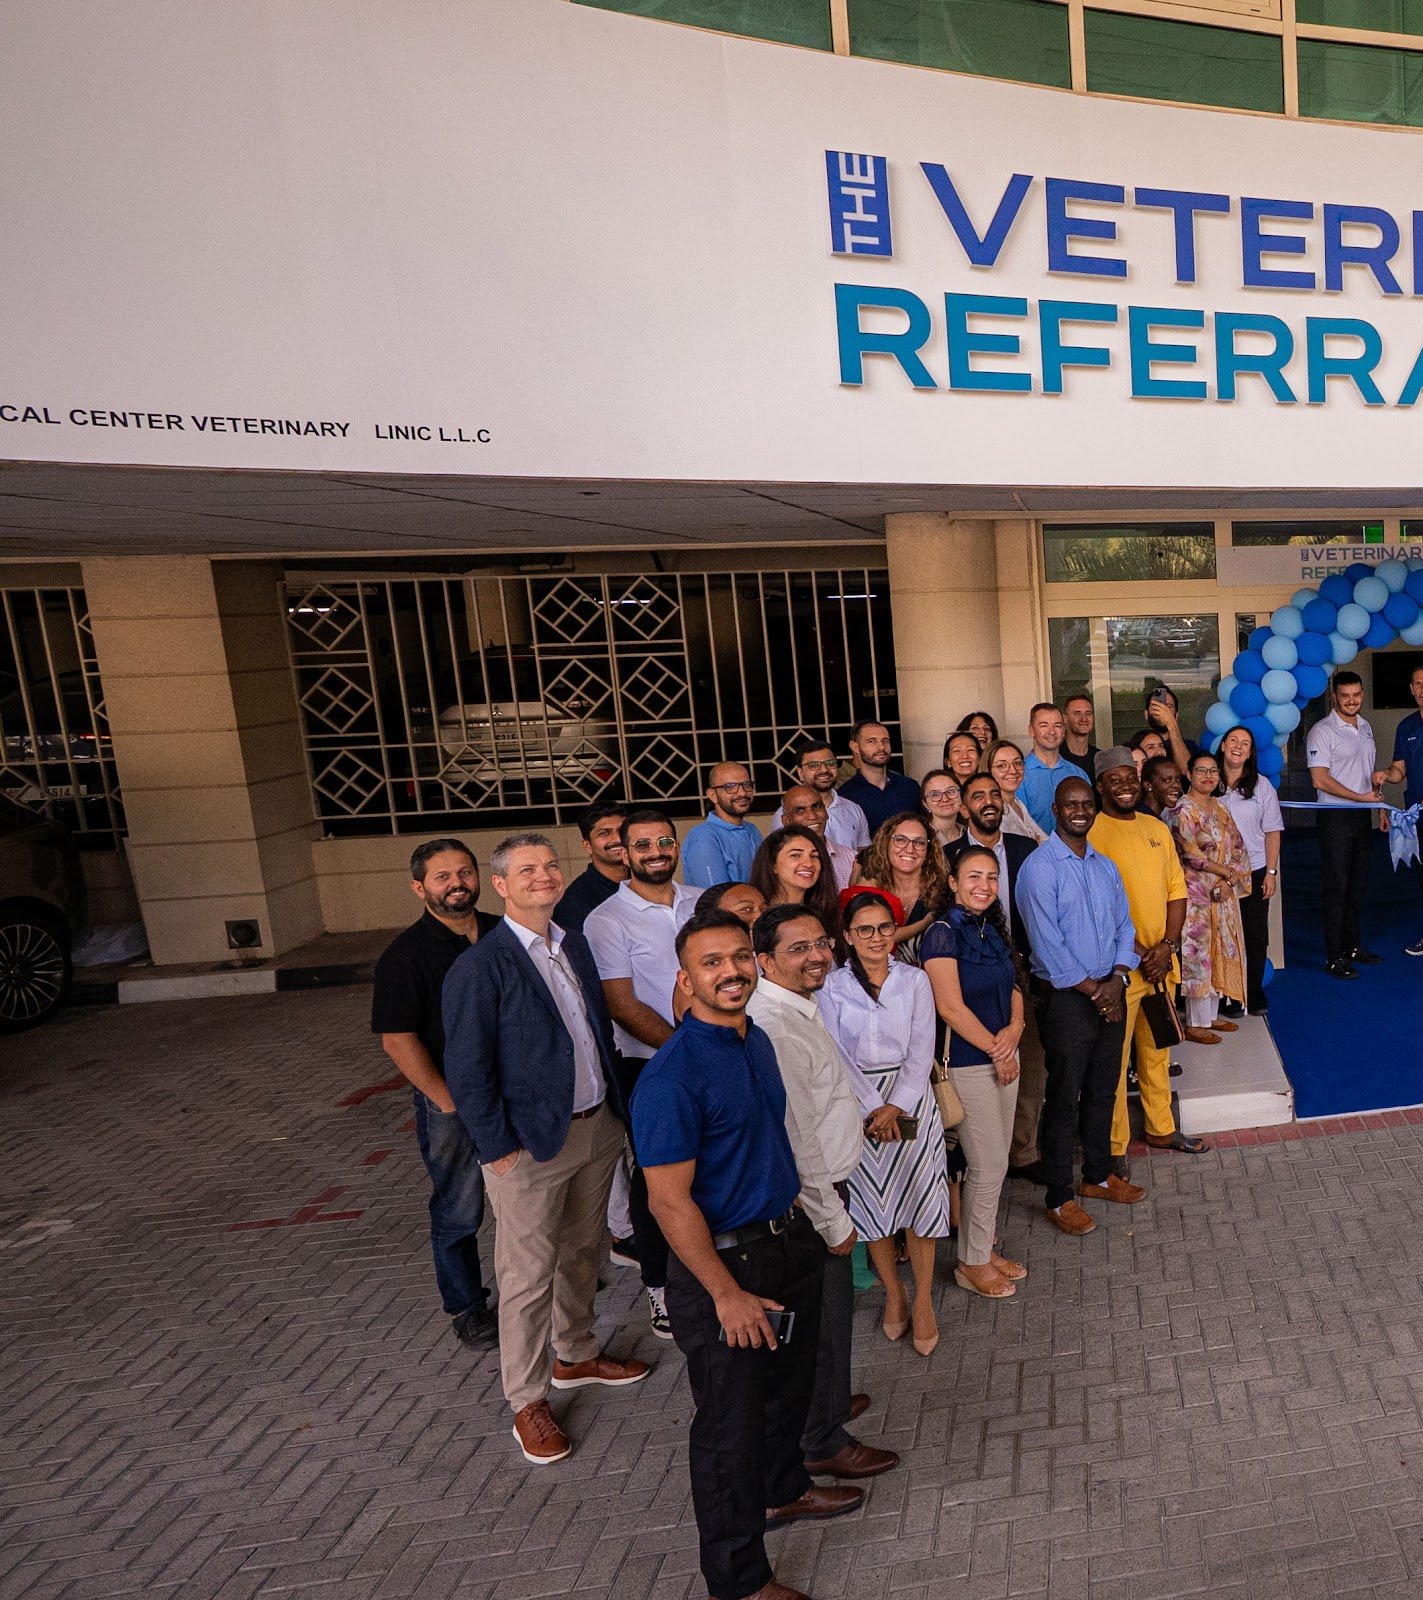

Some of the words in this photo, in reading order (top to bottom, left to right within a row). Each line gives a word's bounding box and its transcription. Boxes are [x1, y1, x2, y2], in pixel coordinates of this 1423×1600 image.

[838, 151, 880, 254] THE
[0, 404, 62, 425] CAL
[69, 408, 185, 431] CENTER
[190, 414, 350, 438] VETERINARY
[374, 424, 432, 441] LINIC
[438, 427, 491, 443] L.L.C
